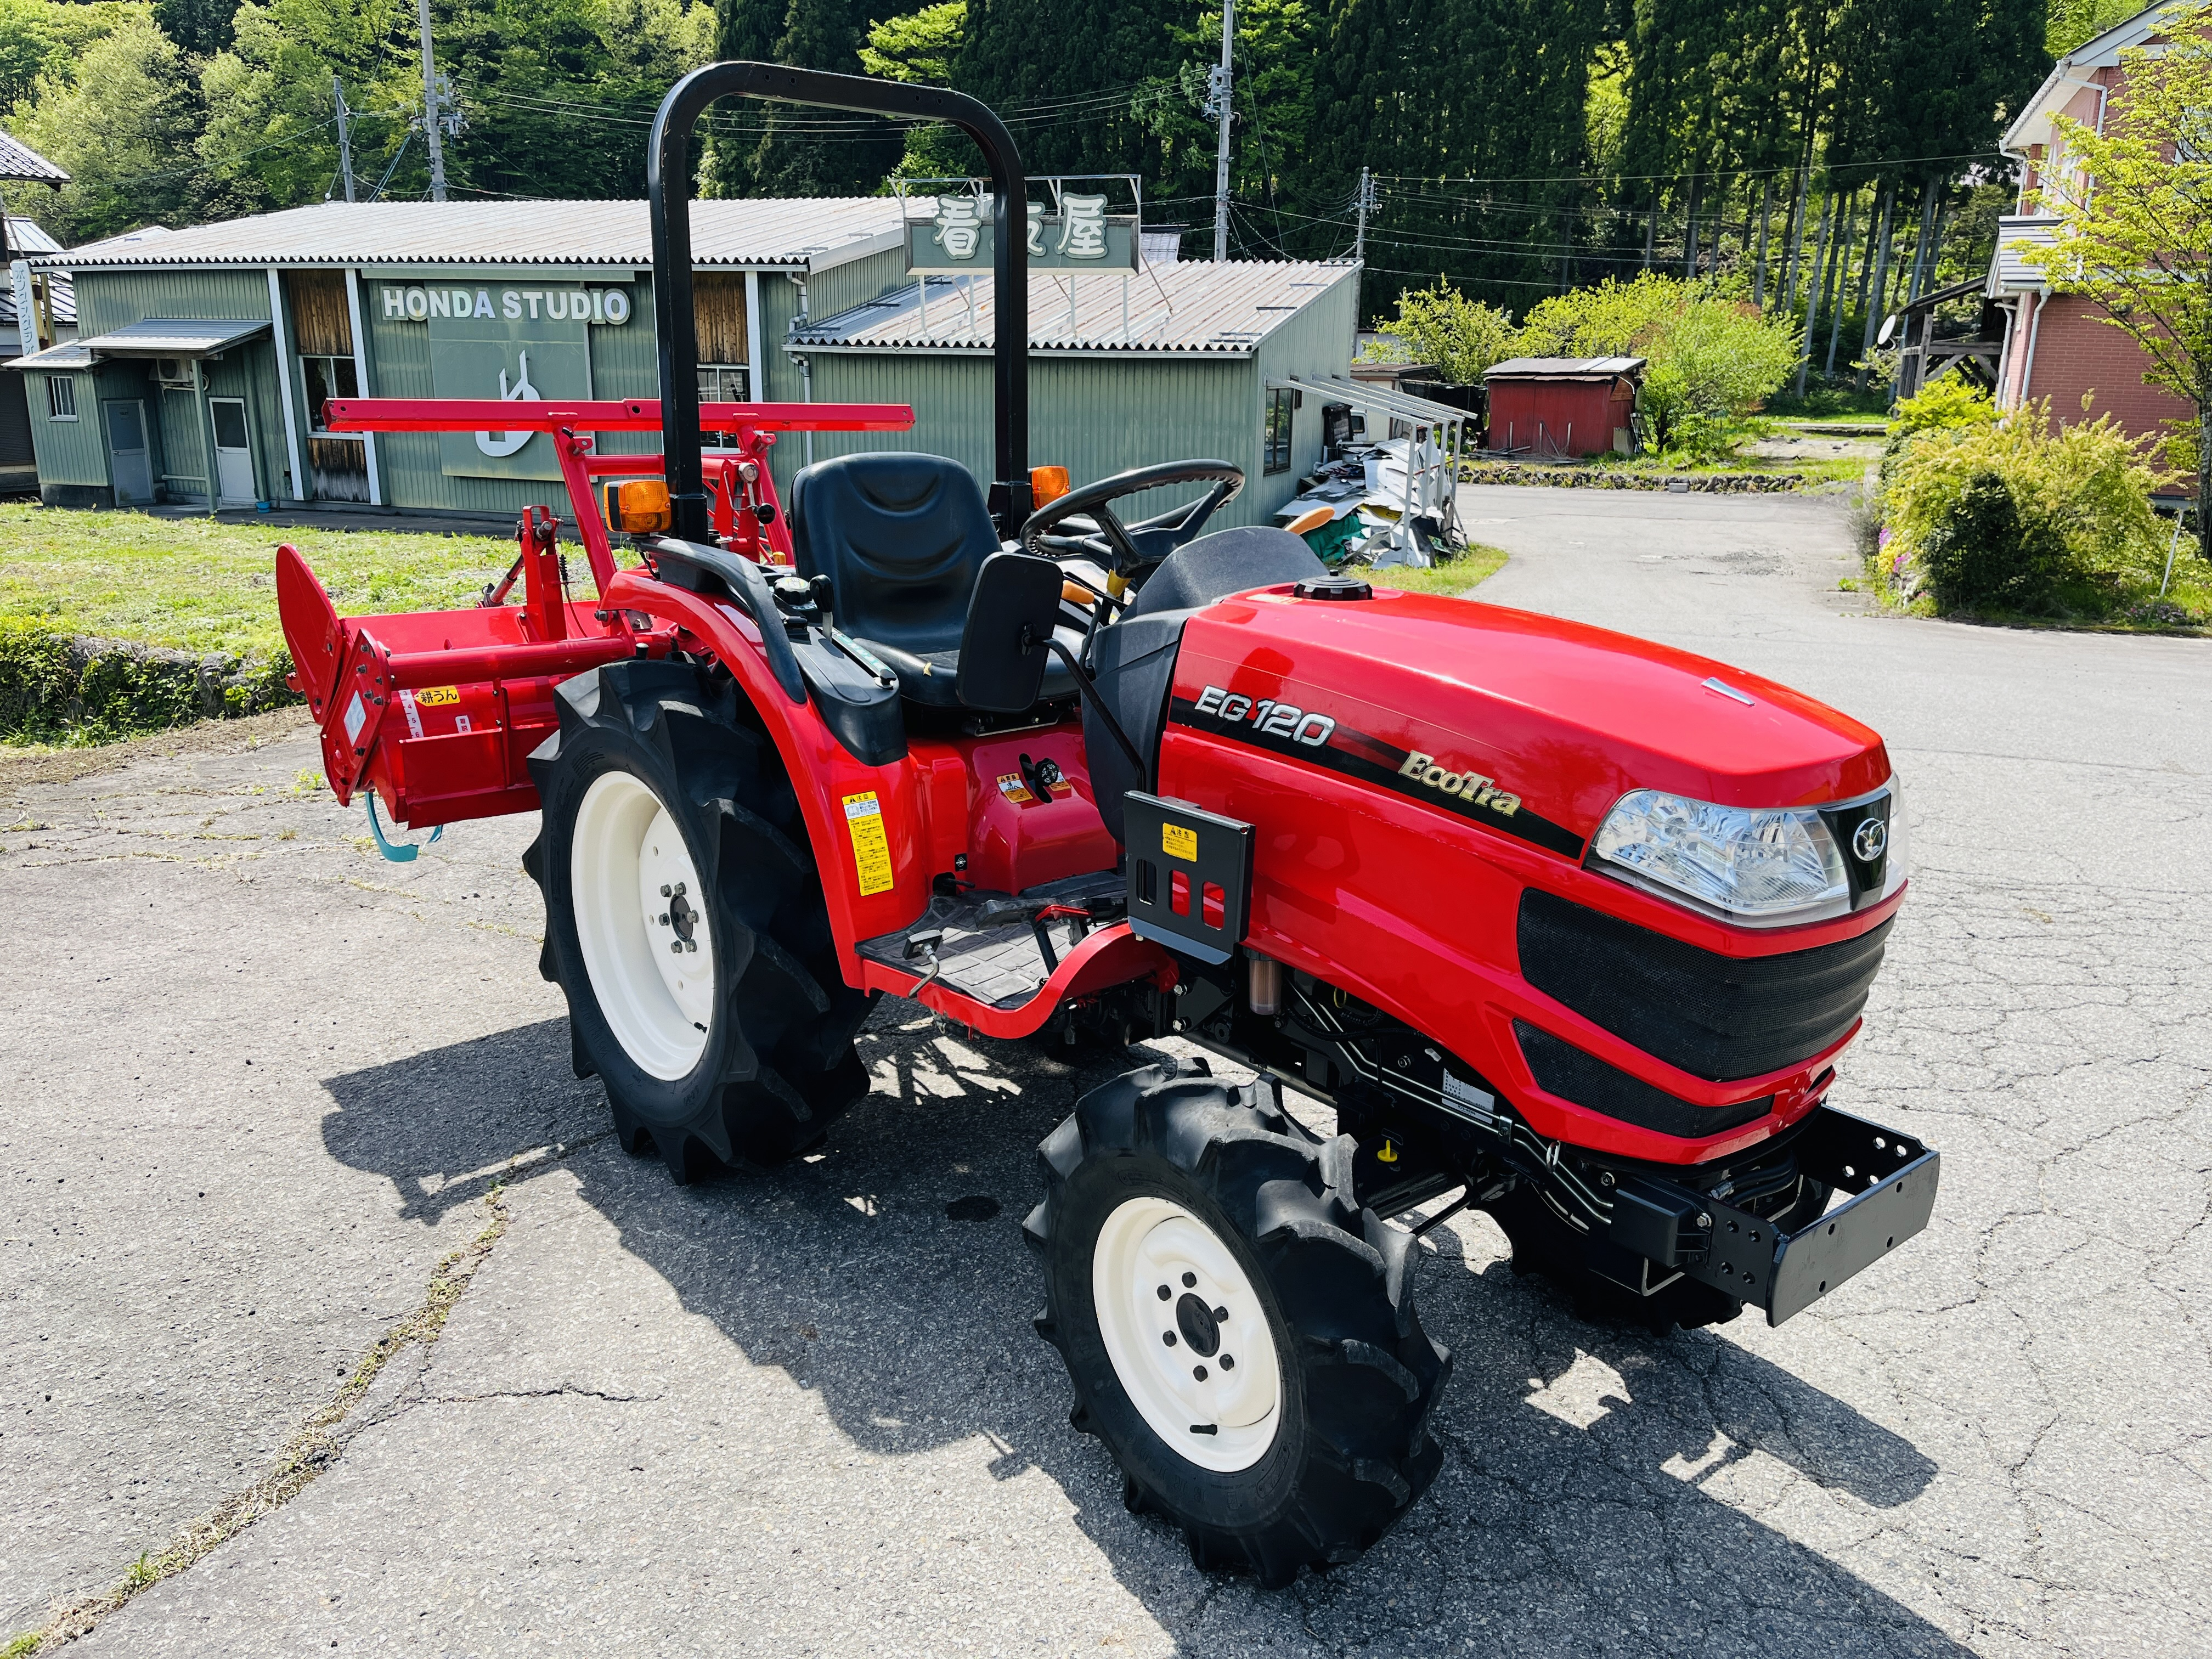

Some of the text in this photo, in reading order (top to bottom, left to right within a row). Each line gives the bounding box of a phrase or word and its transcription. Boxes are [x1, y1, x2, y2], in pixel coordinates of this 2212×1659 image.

[383, 290, 628, 320] HONDA STUDIO
[421, 689, 458, 703] 耕うん
[1194, 685, 1337, 747] EG 120
[1398, 749, 1522, 817] EcoTra
